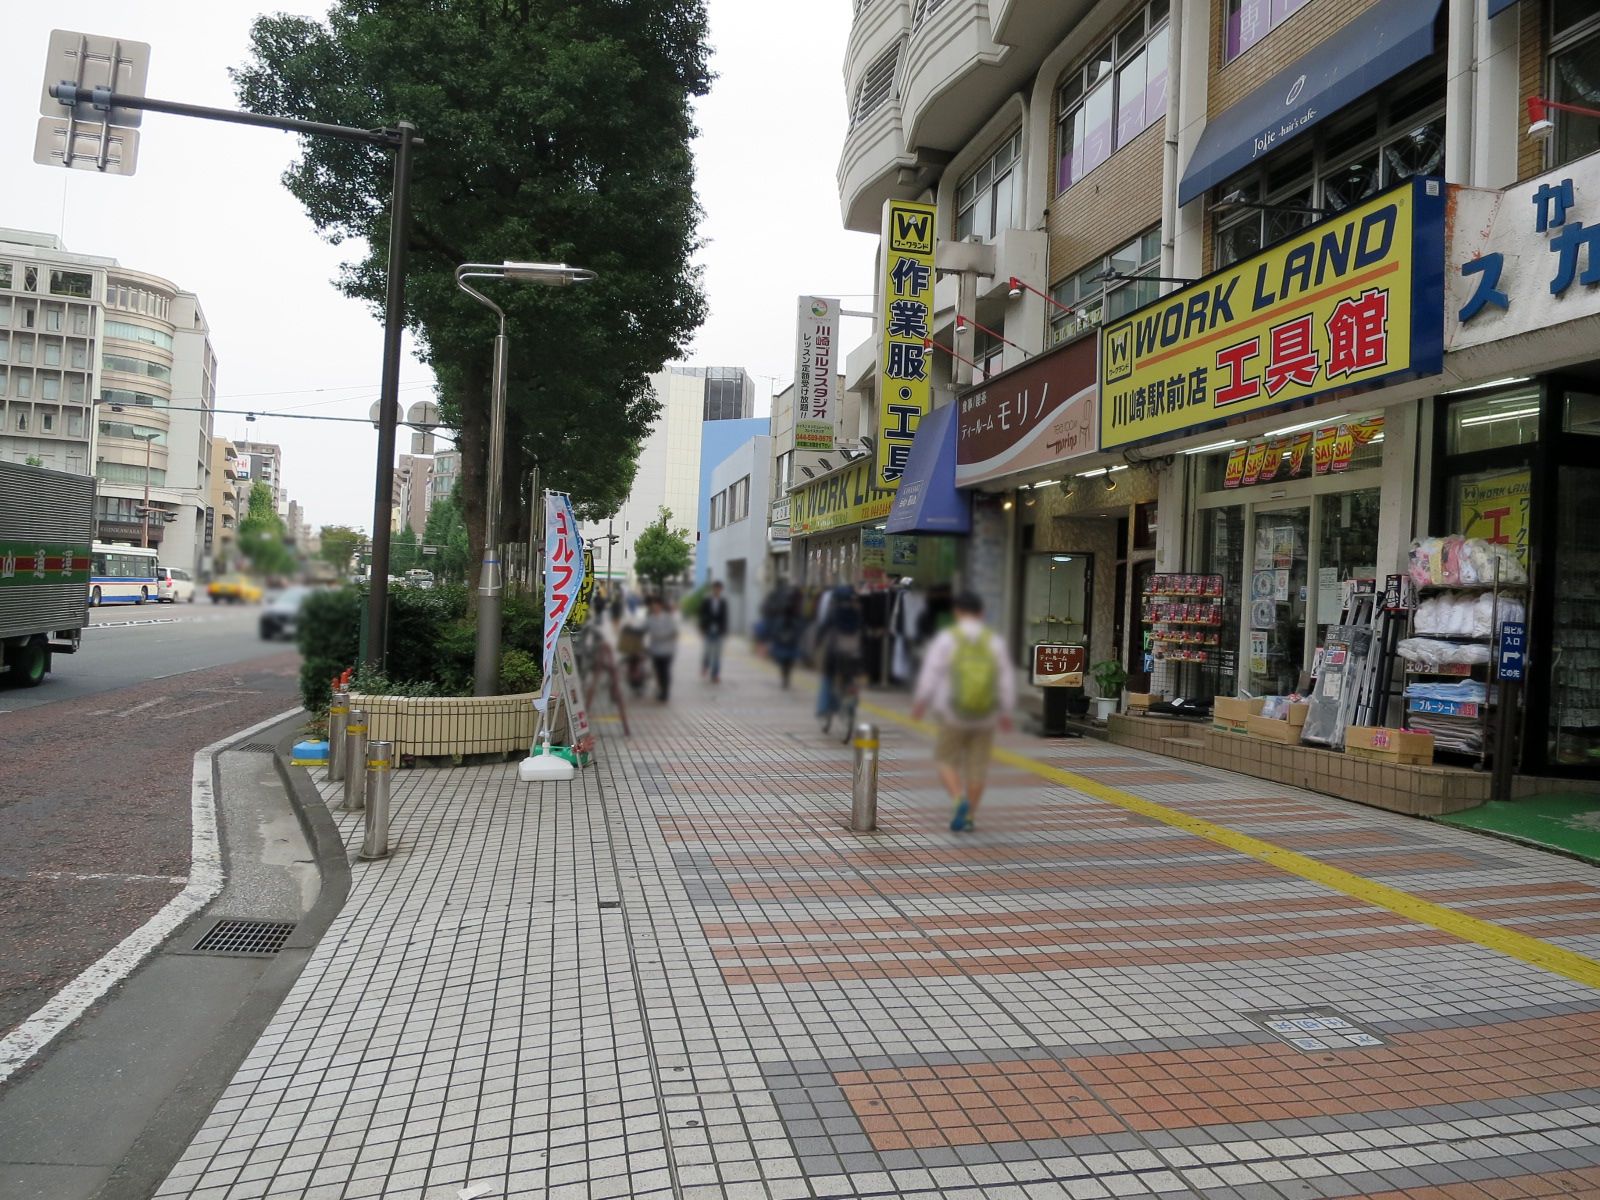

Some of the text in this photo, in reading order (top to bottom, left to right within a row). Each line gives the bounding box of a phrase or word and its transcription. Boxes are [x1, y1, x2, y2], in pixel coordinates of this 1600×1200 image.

[1252, 130, 1276, 158] Jolie
[1135, 203, 1397, 358] WORK LAND
[1213, 286, 1389, 409] 工具館
[812, 325, 831, 419] 川崎ゴルフスタジオ
[997, 382, 1048, 431] モリノ
[1111, 367, 1208, 428] 川崎駅前店
[807, 470, 851, 519] WORK
[1507, 482, 1530, 495] LAN
[1483, 506, 1511, 545] 工
[1515, 498, 1530, 563] ワークラ
[1503, 626, 1524, 635] 当ビル
[1505, 636, 1520, 646] 入口
[1044, 661, 1080, 671] モリノ
[1500, 668, 1520, 678] この先
[1419, 700, 1455, 714] ブルーシート
